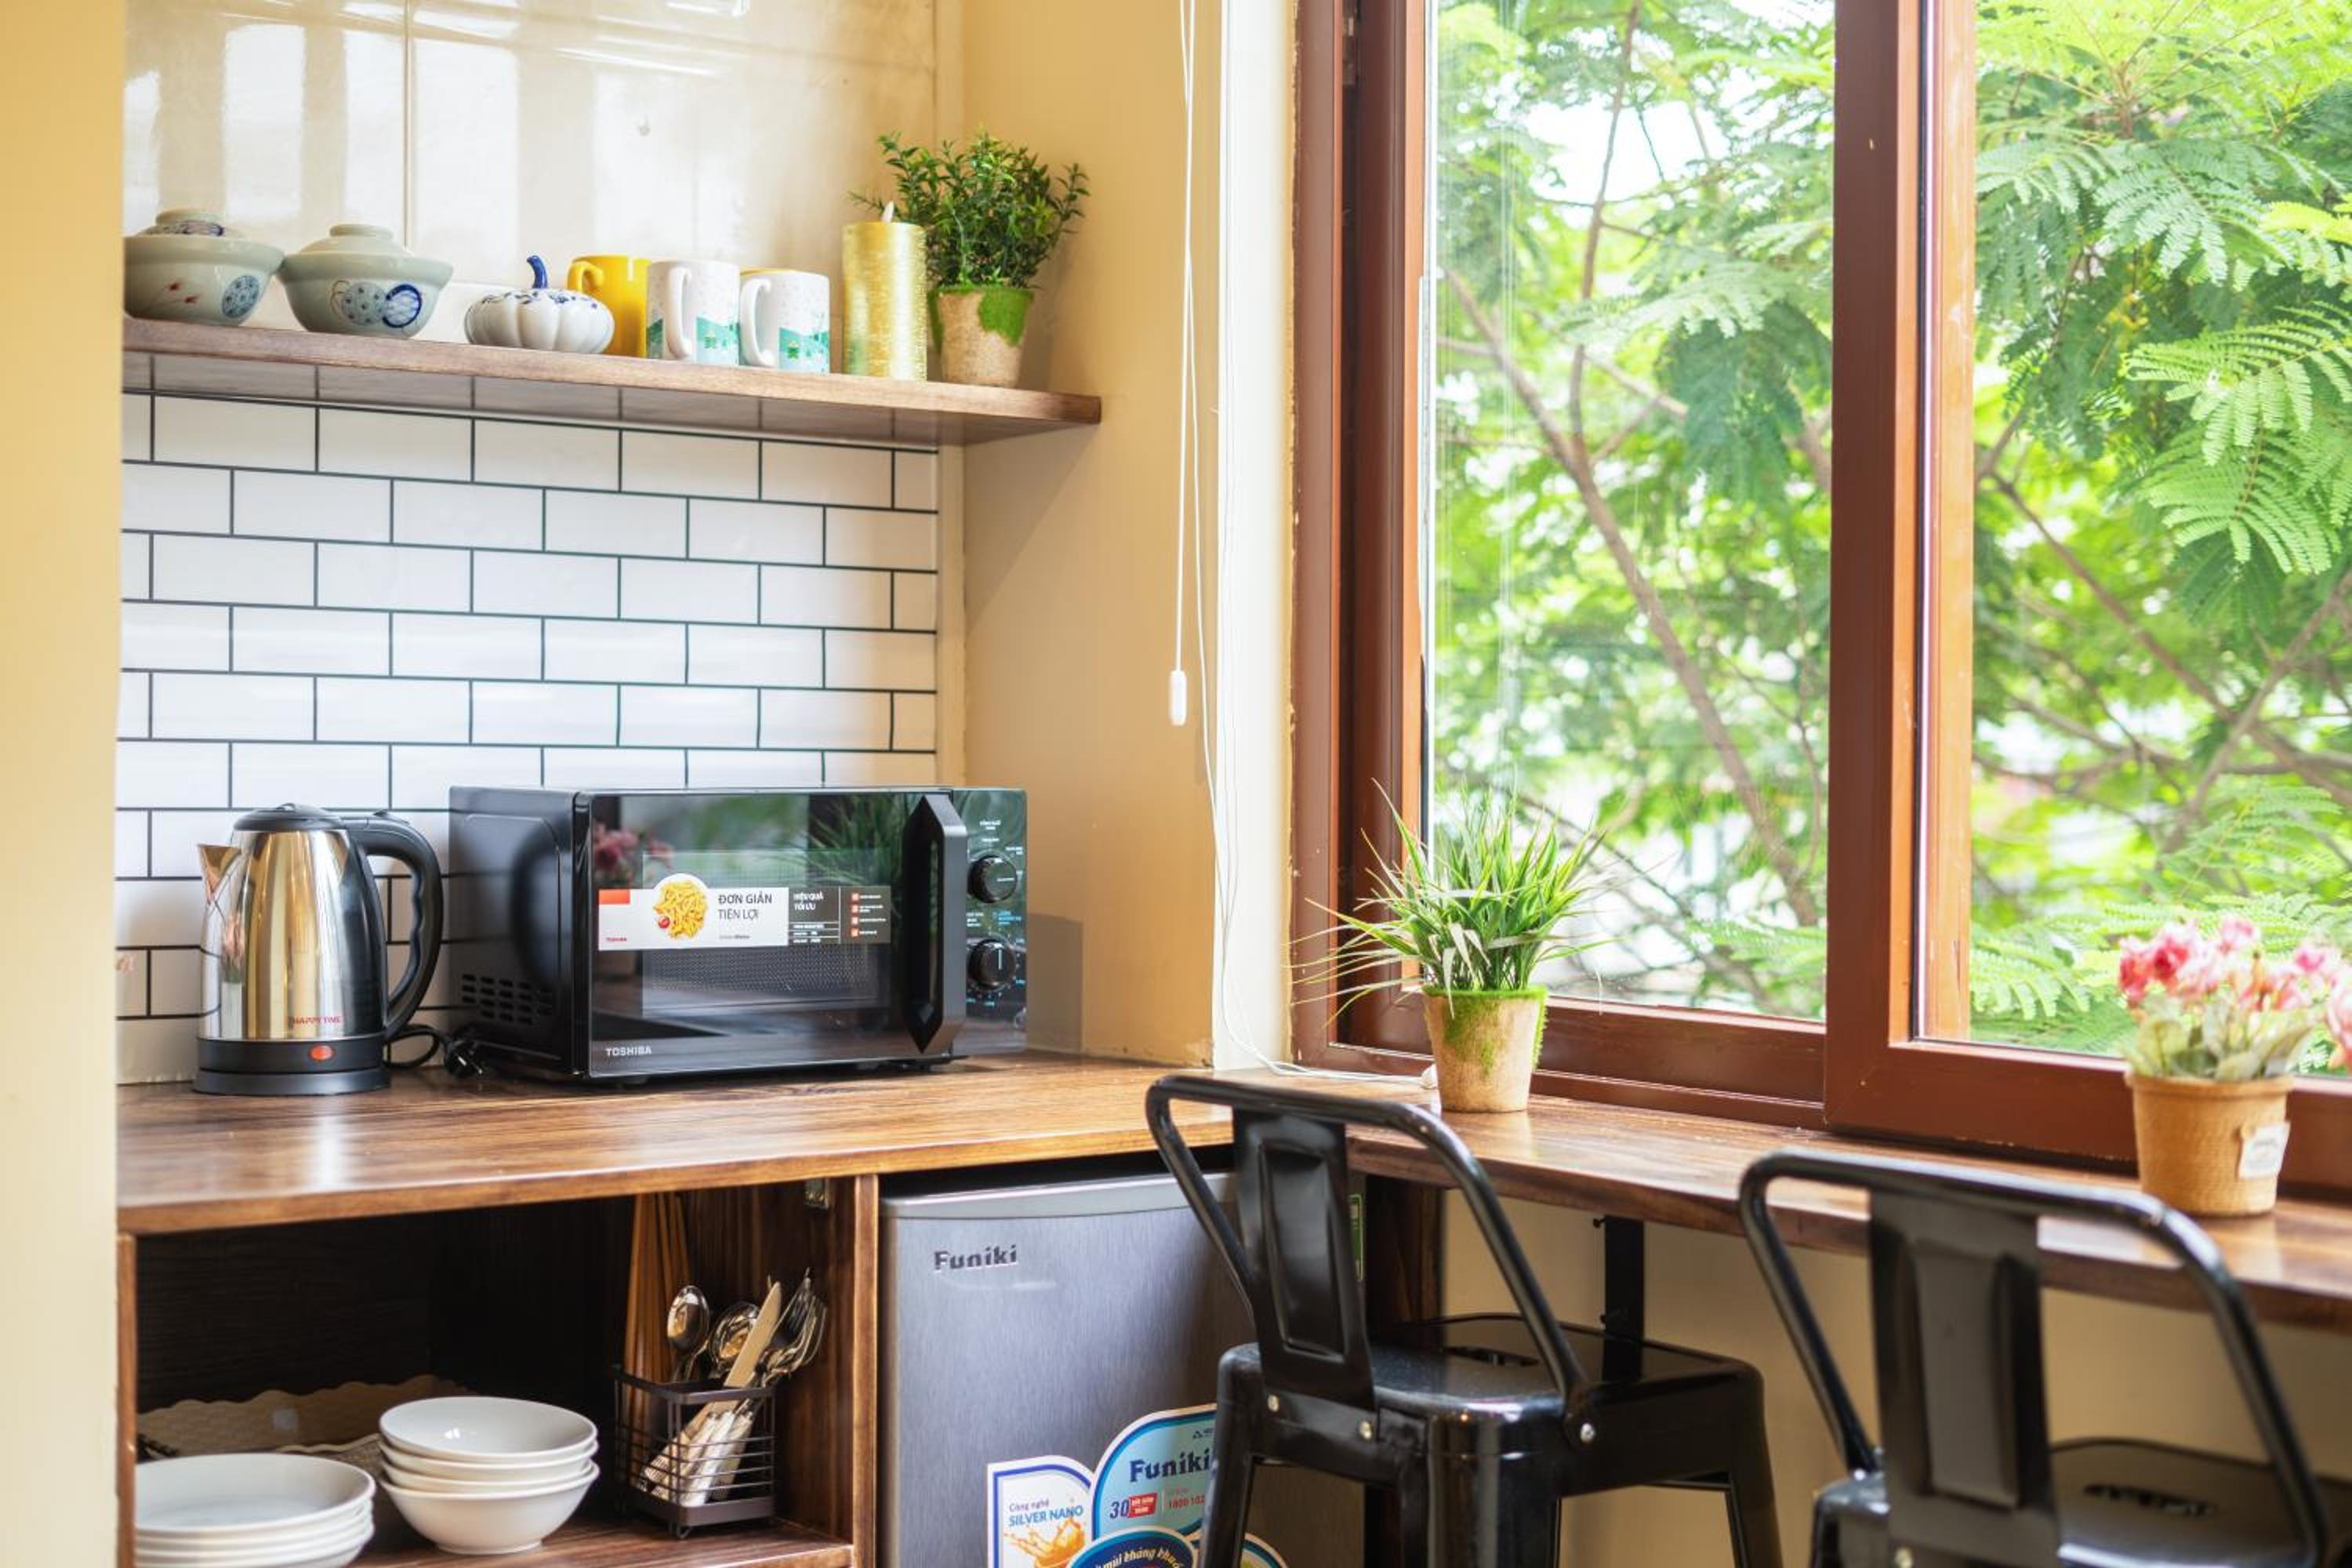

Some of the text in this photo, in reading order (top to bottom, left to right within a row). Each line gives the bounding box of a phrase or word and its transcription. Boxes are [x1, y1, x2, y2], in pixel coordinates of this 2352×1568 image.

[606, 1046, 652, 1057] TOSHIBA
[934, 1244, 1017, 1270] Funiki
[1129, 1448, 1210, 1482] Funiki
[1009, 1504, 1083, 1526] SILVER NANO
[1109, 1498, 1130, 1518] 30
